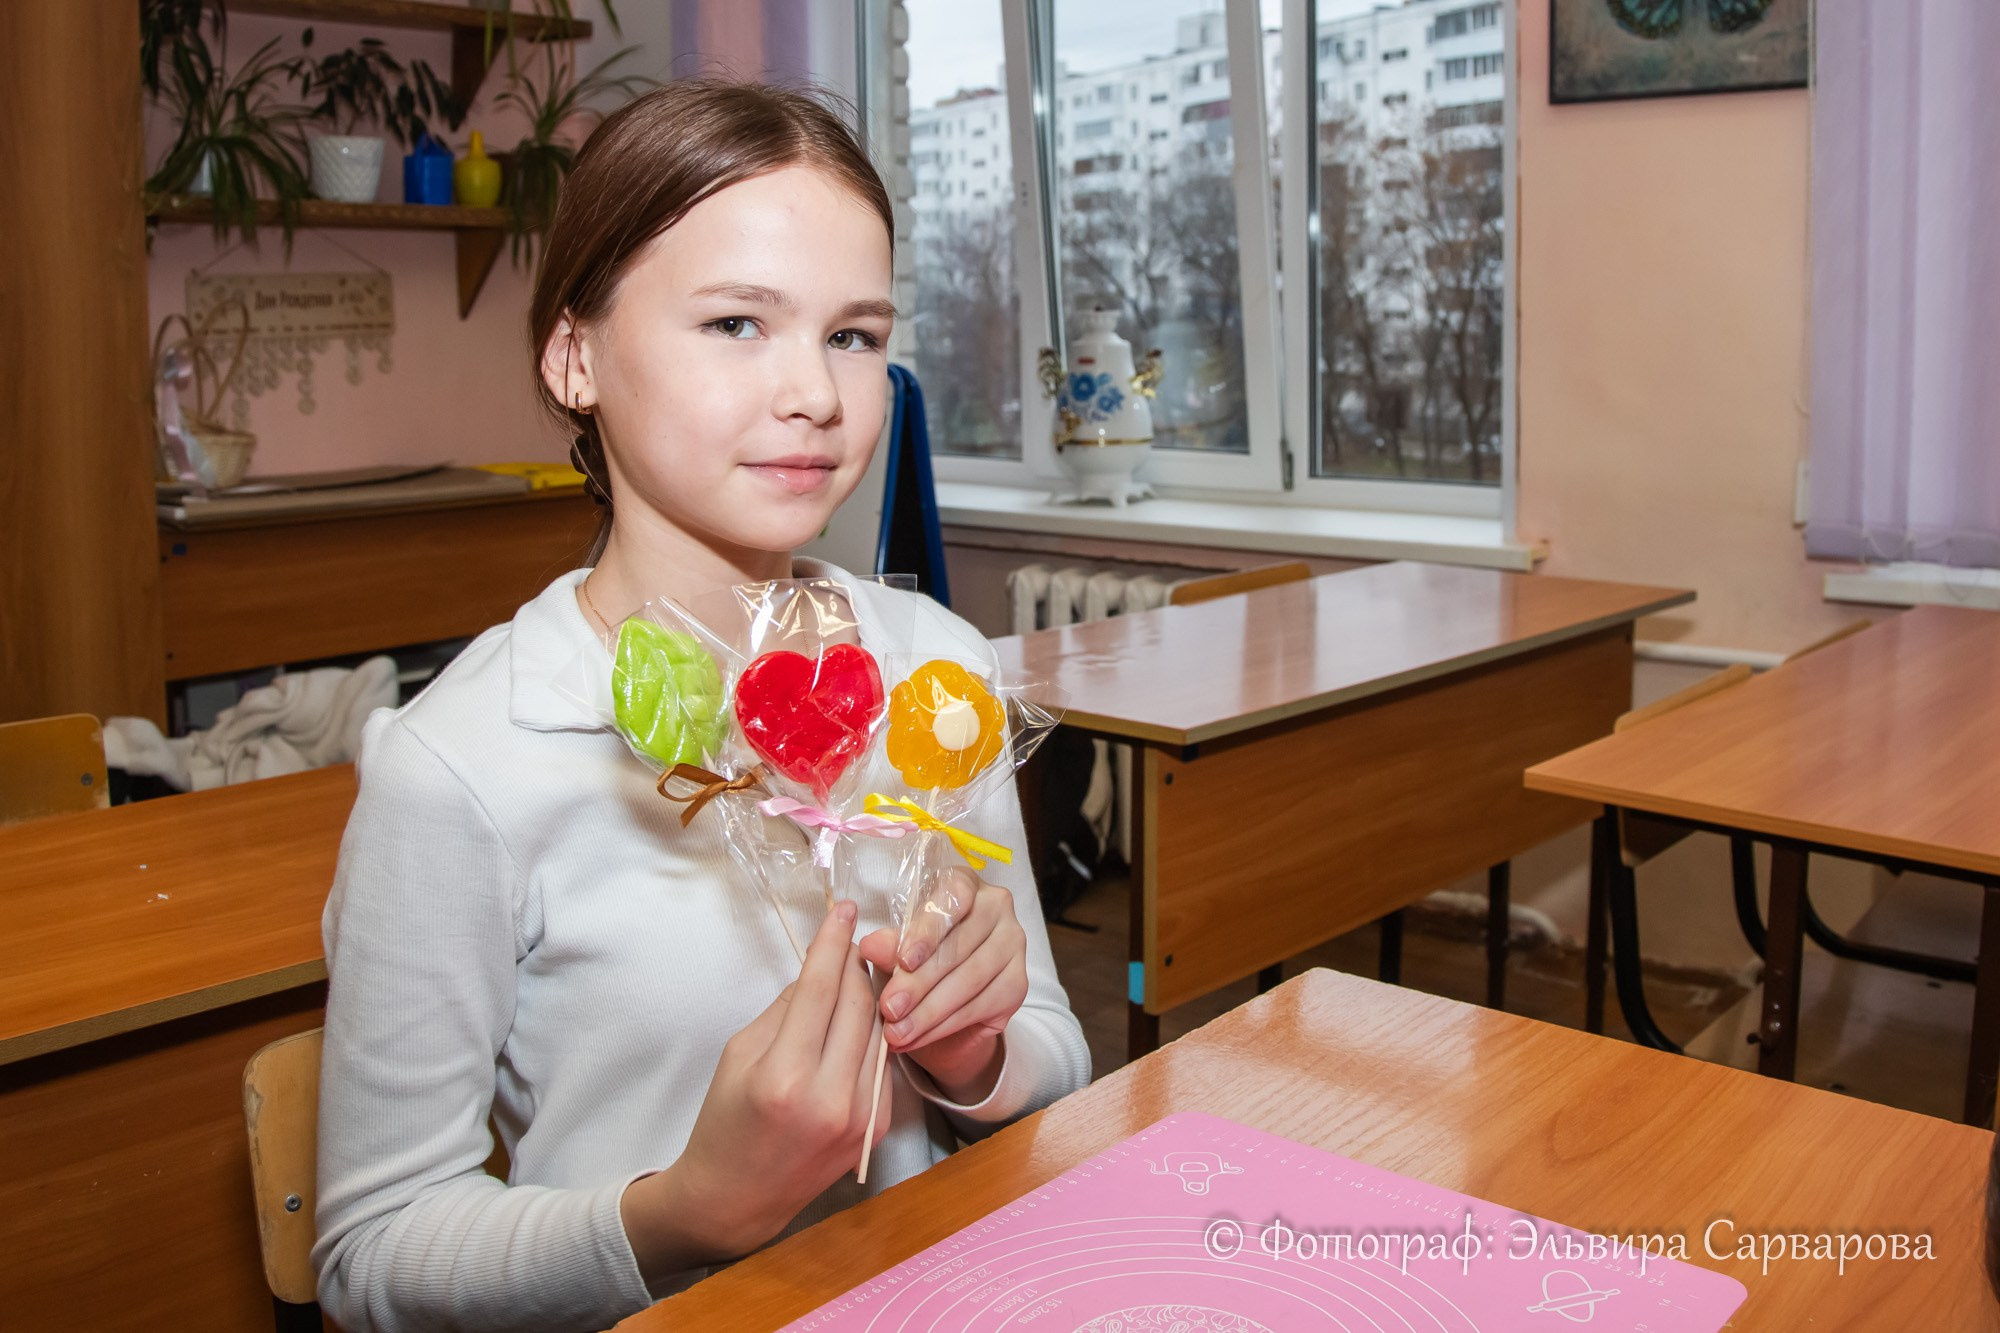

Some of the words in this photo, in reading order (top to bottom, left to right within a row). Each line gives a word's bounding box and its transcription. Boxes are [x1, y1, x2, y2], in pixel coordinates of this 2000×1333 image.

[995, 1217, 1009, 1225] 11
[980, 1225, 995, 1233] 12
[966, 1233, 980, 1241] 13
[951, 1241, 965, 1249] 14
[1443, 1211, 1458, 1219] 15
[1604, 1263, 1622, 1272] 23
[1648, 1277, 1664, 1287] 25
[935, 1250, 950, 1258] 15
[919, 1258, 934, 1267] 16
[905, 1267, 918, 1276] 17
[888, 1276, 902, 1285] 18
[872, 1284, 886, 1293] 19
[854, 1292, 870, 1302] 20
[838, 1302, 853, 1312] 21
[1018, 1299, 1062, 1324] 15.2cms
[821, 1311, 836, 1322] 22
[802, 1321, 819, 1331] 23
